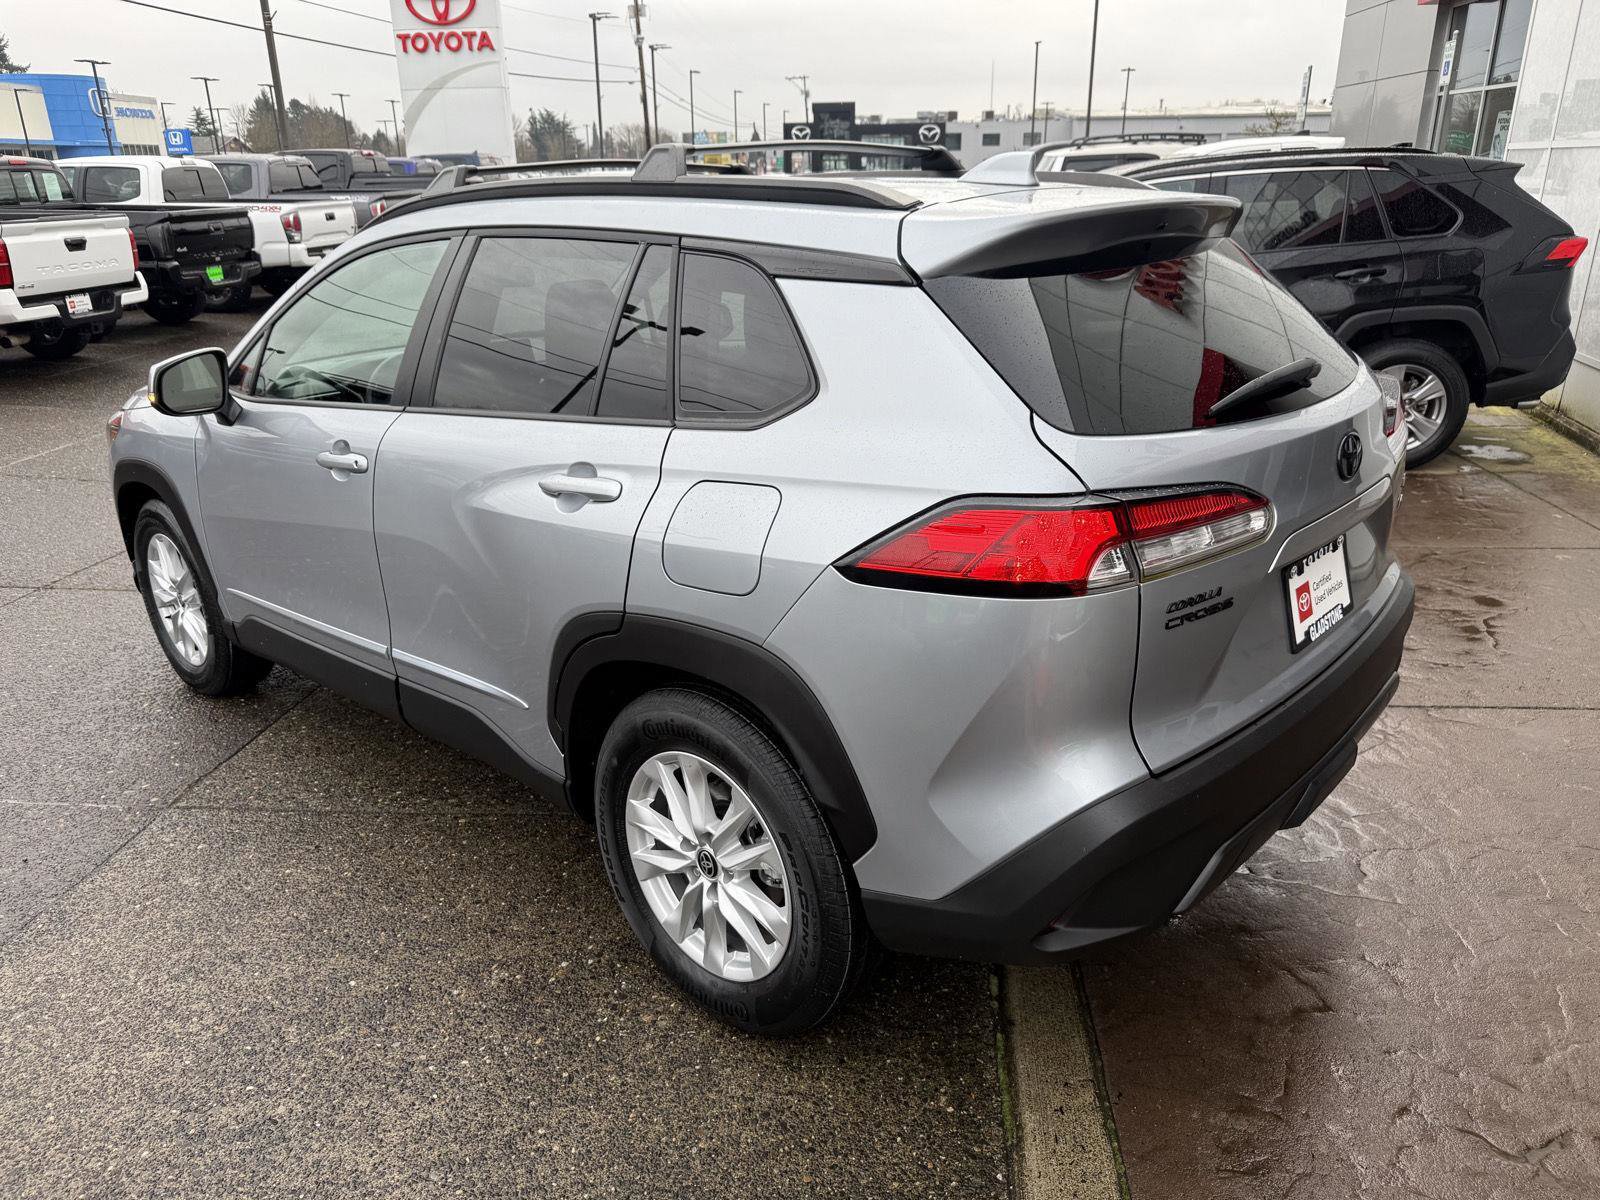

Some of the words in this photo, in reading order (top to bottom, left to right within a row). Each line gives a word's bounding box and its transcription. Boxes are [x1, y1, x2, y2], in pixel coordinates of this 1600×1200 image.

[396, 31, 495, 54] TOYOTA
[115, 106, 155, 119] HONDA
[36, 258, 120, 276] TACOMA
[1302, 541, 1334, 567] TOYOTA
[1312, 571, 1332, 592] Certified
[1314, 591, 1326, 606] Used
[1326, 579, 1344, 599] Vehicles
[1166, 586, 1222, 614] COROLLA
[1165, 597, 1233, 630] CROSS
[1309, 604, 1344, 642] GLADSTONE
